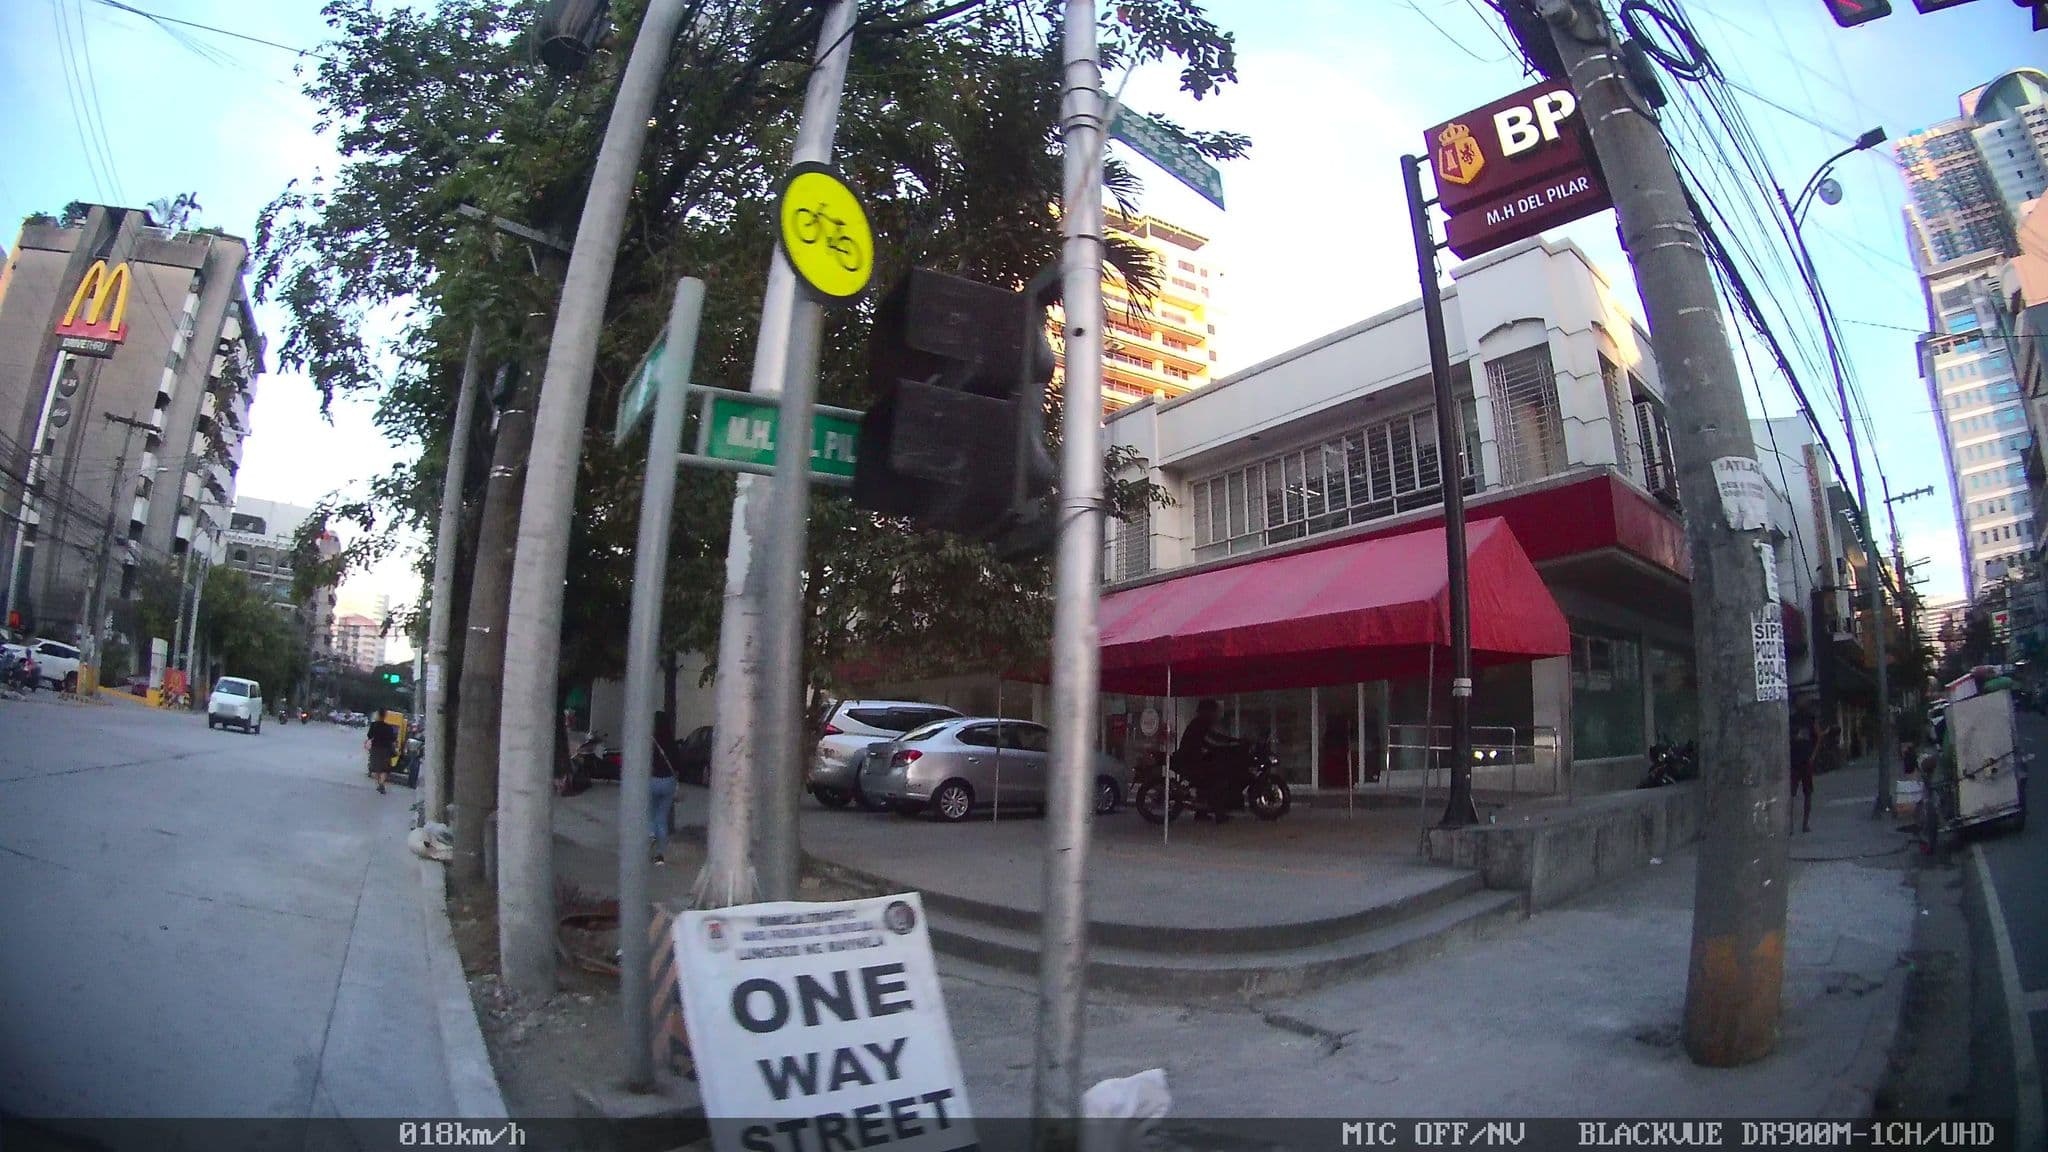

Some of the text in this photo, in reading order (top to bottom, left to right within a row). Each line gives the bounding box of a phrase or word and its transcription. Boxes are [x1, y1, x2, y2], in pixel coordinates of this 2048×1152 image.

[1493, 89, 1576, 157] BP
[1487, 176, 1589, 226] M.H DEL PILAR
[823, 430, 857, 463] PIL
[731, 962, 914, 1034] ONE
[756, 1036, 909, 1101] WAY
[741, 1087, 955, 1152] STREET
